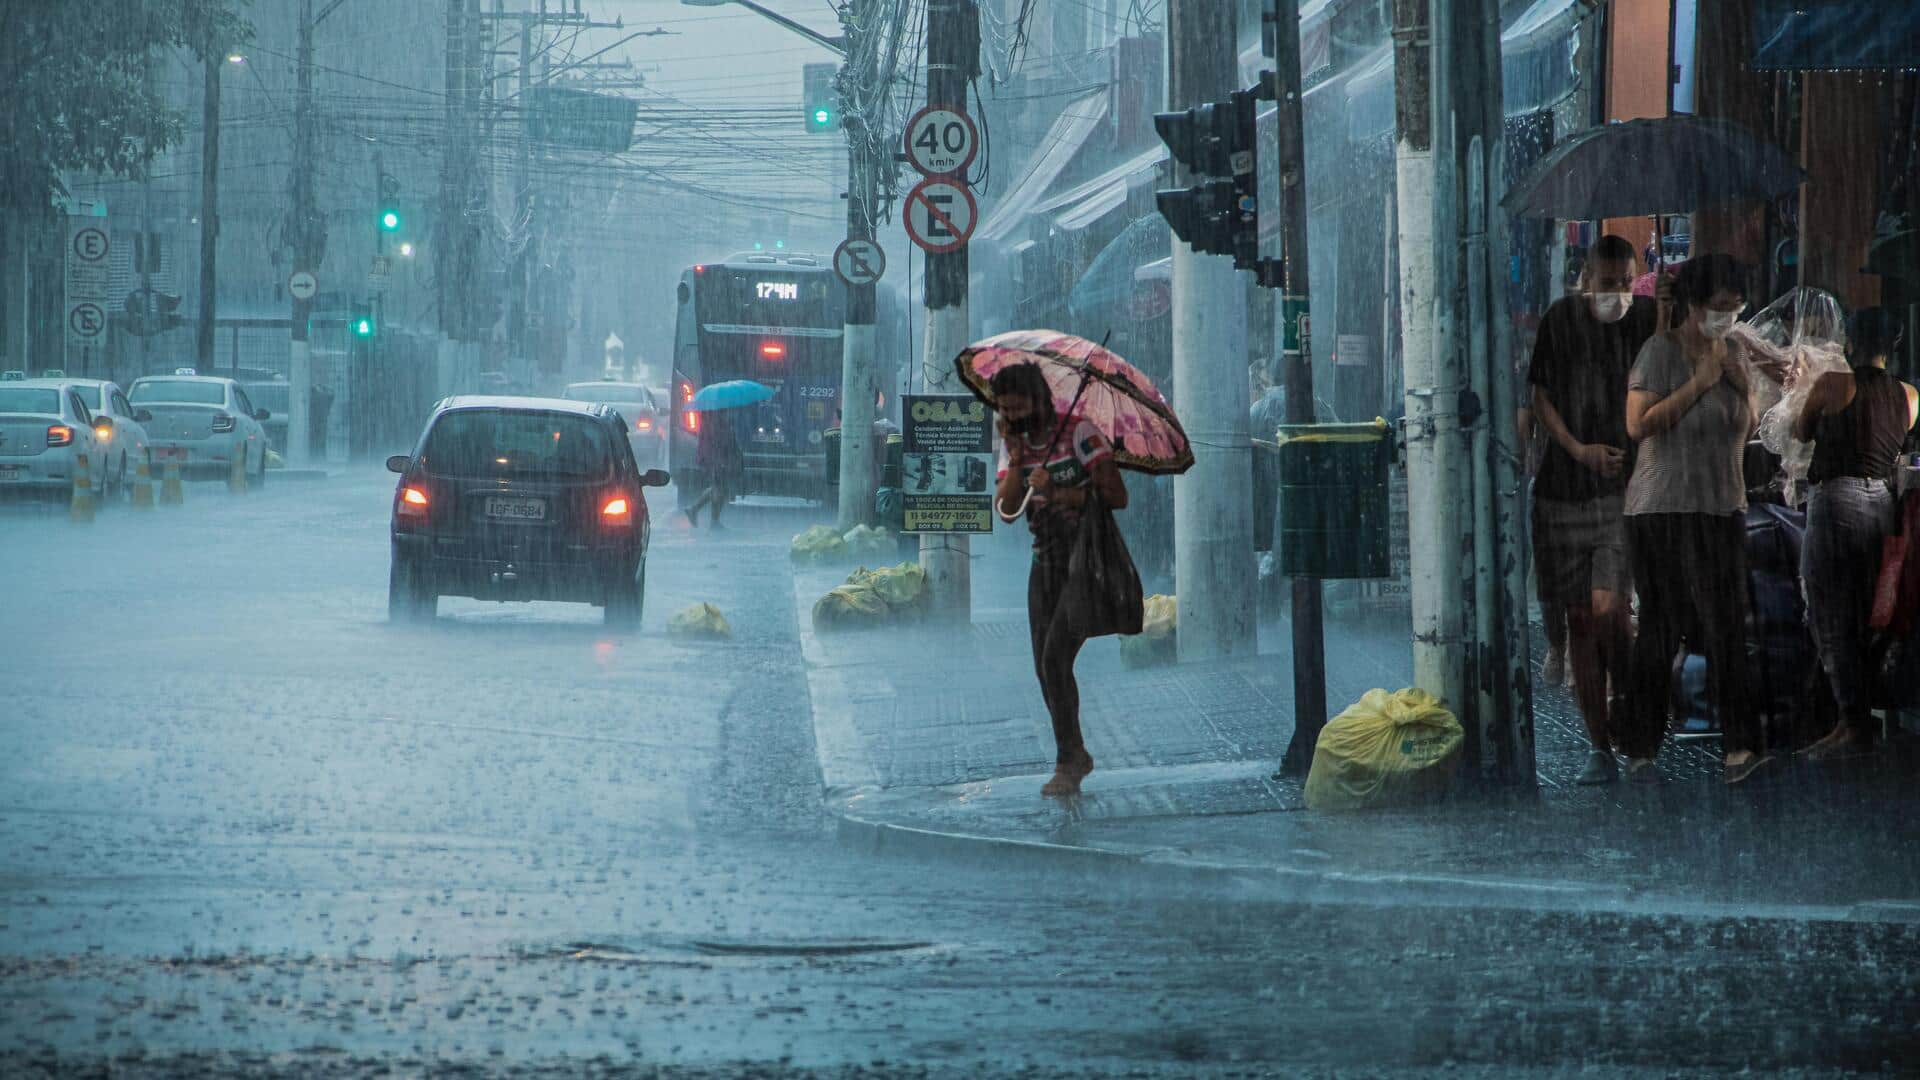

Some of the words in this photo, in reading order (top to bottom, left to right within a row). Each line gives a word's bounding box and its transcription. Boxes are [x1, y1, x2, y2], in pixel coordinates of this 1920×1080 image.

[915, 121, 966, 154] 40
[928, 157, 955, 167] km/h
[927, 195, 953, 237] E
[85, 235, 99, 255] E
[850, 247, 870, 277] E
[756, 282, 798, 299] 174M
[809, 387, 834, 398] 2292
